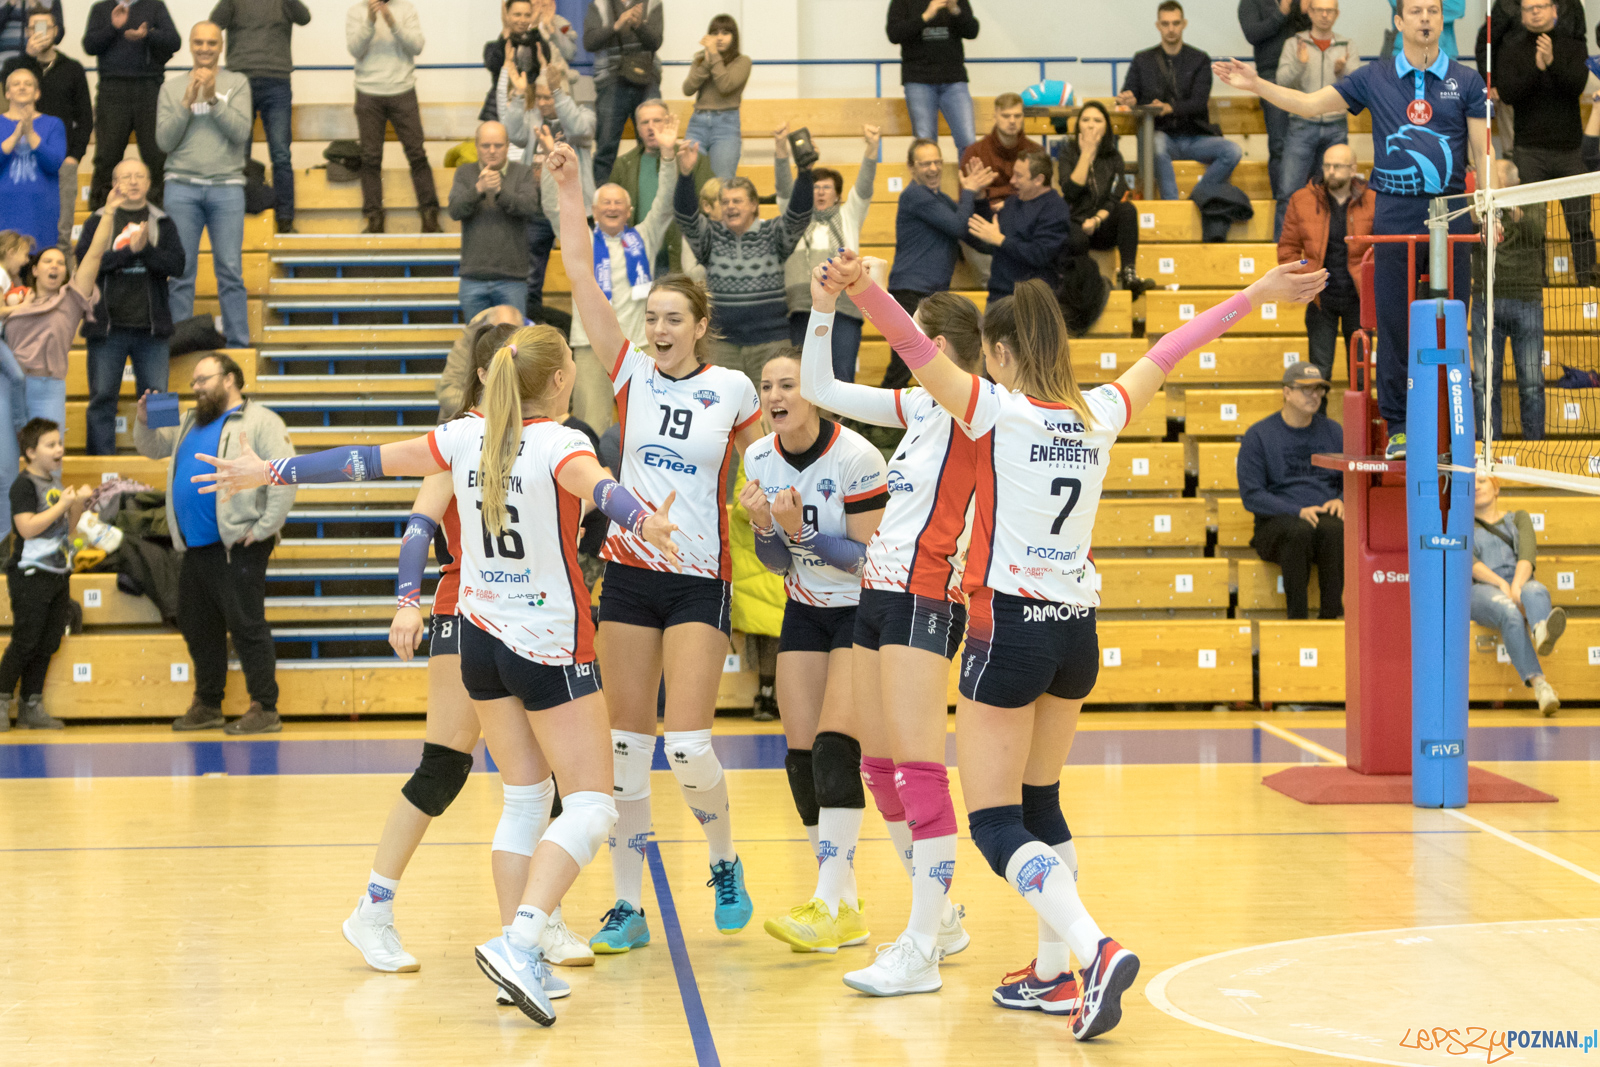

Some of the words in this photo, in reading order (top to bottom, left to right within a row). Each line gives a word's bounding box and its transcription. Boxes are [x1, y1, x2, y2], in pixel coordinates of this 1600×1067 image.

[1452, 384, 1464, 435] Senoh
[659, 404, 692, 440] 19
[644, 452, 698, 476] Enea
[1030, 444, 1100, 466] ENERGETYK
[1356, 462, 1388, 472] Senoh
[1050, 477, 1082, 534] 7
[476, 500, 526, 560] 16
[441, 620, 453, 638] 8
[1304, 651, 1314, 660] 16
[78, 666, 88, 675] 10
